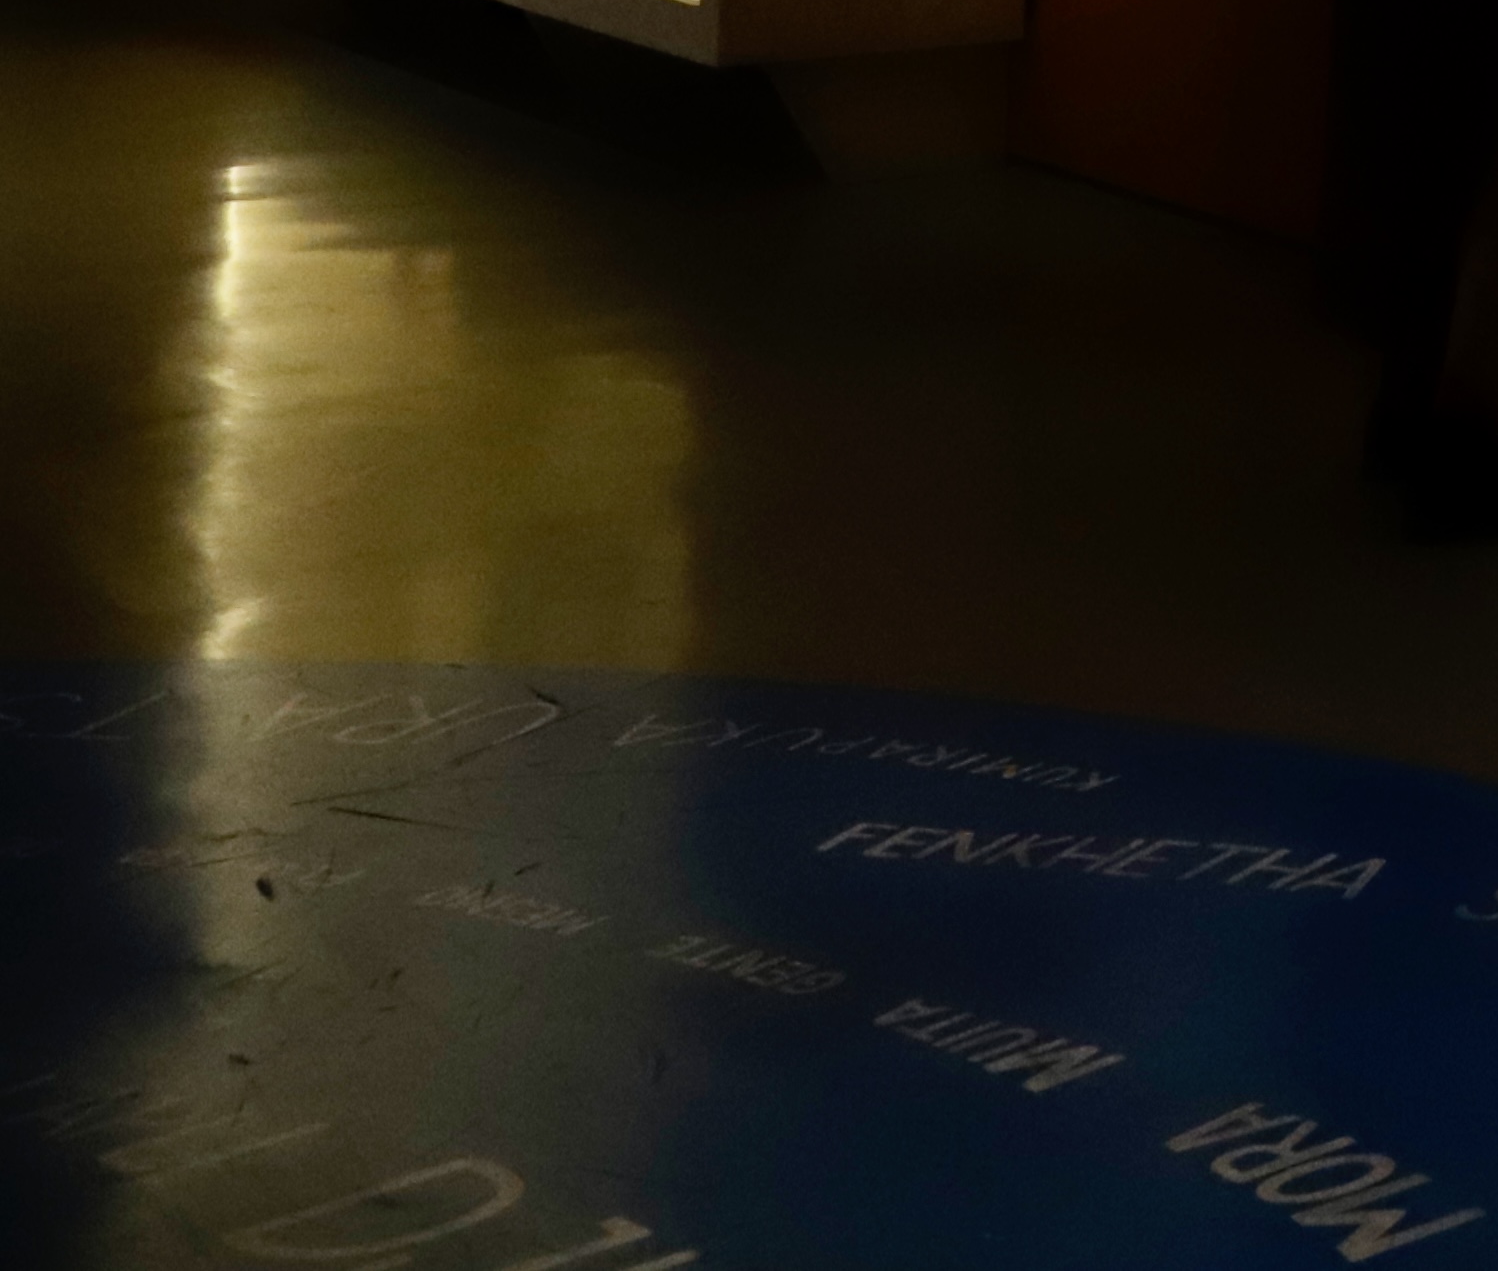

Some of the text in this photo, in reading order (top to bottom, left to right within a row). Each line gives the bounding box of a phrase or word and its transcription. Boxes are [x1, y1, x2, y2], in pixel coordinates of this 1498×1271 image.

[816, 820, 1387, 900] FENKHETHA
[646, 931, 848, 997] GENTE
[872, 994, 1127, 1095] MUITA
[1163, 1099, 1487, 1264] MORA
